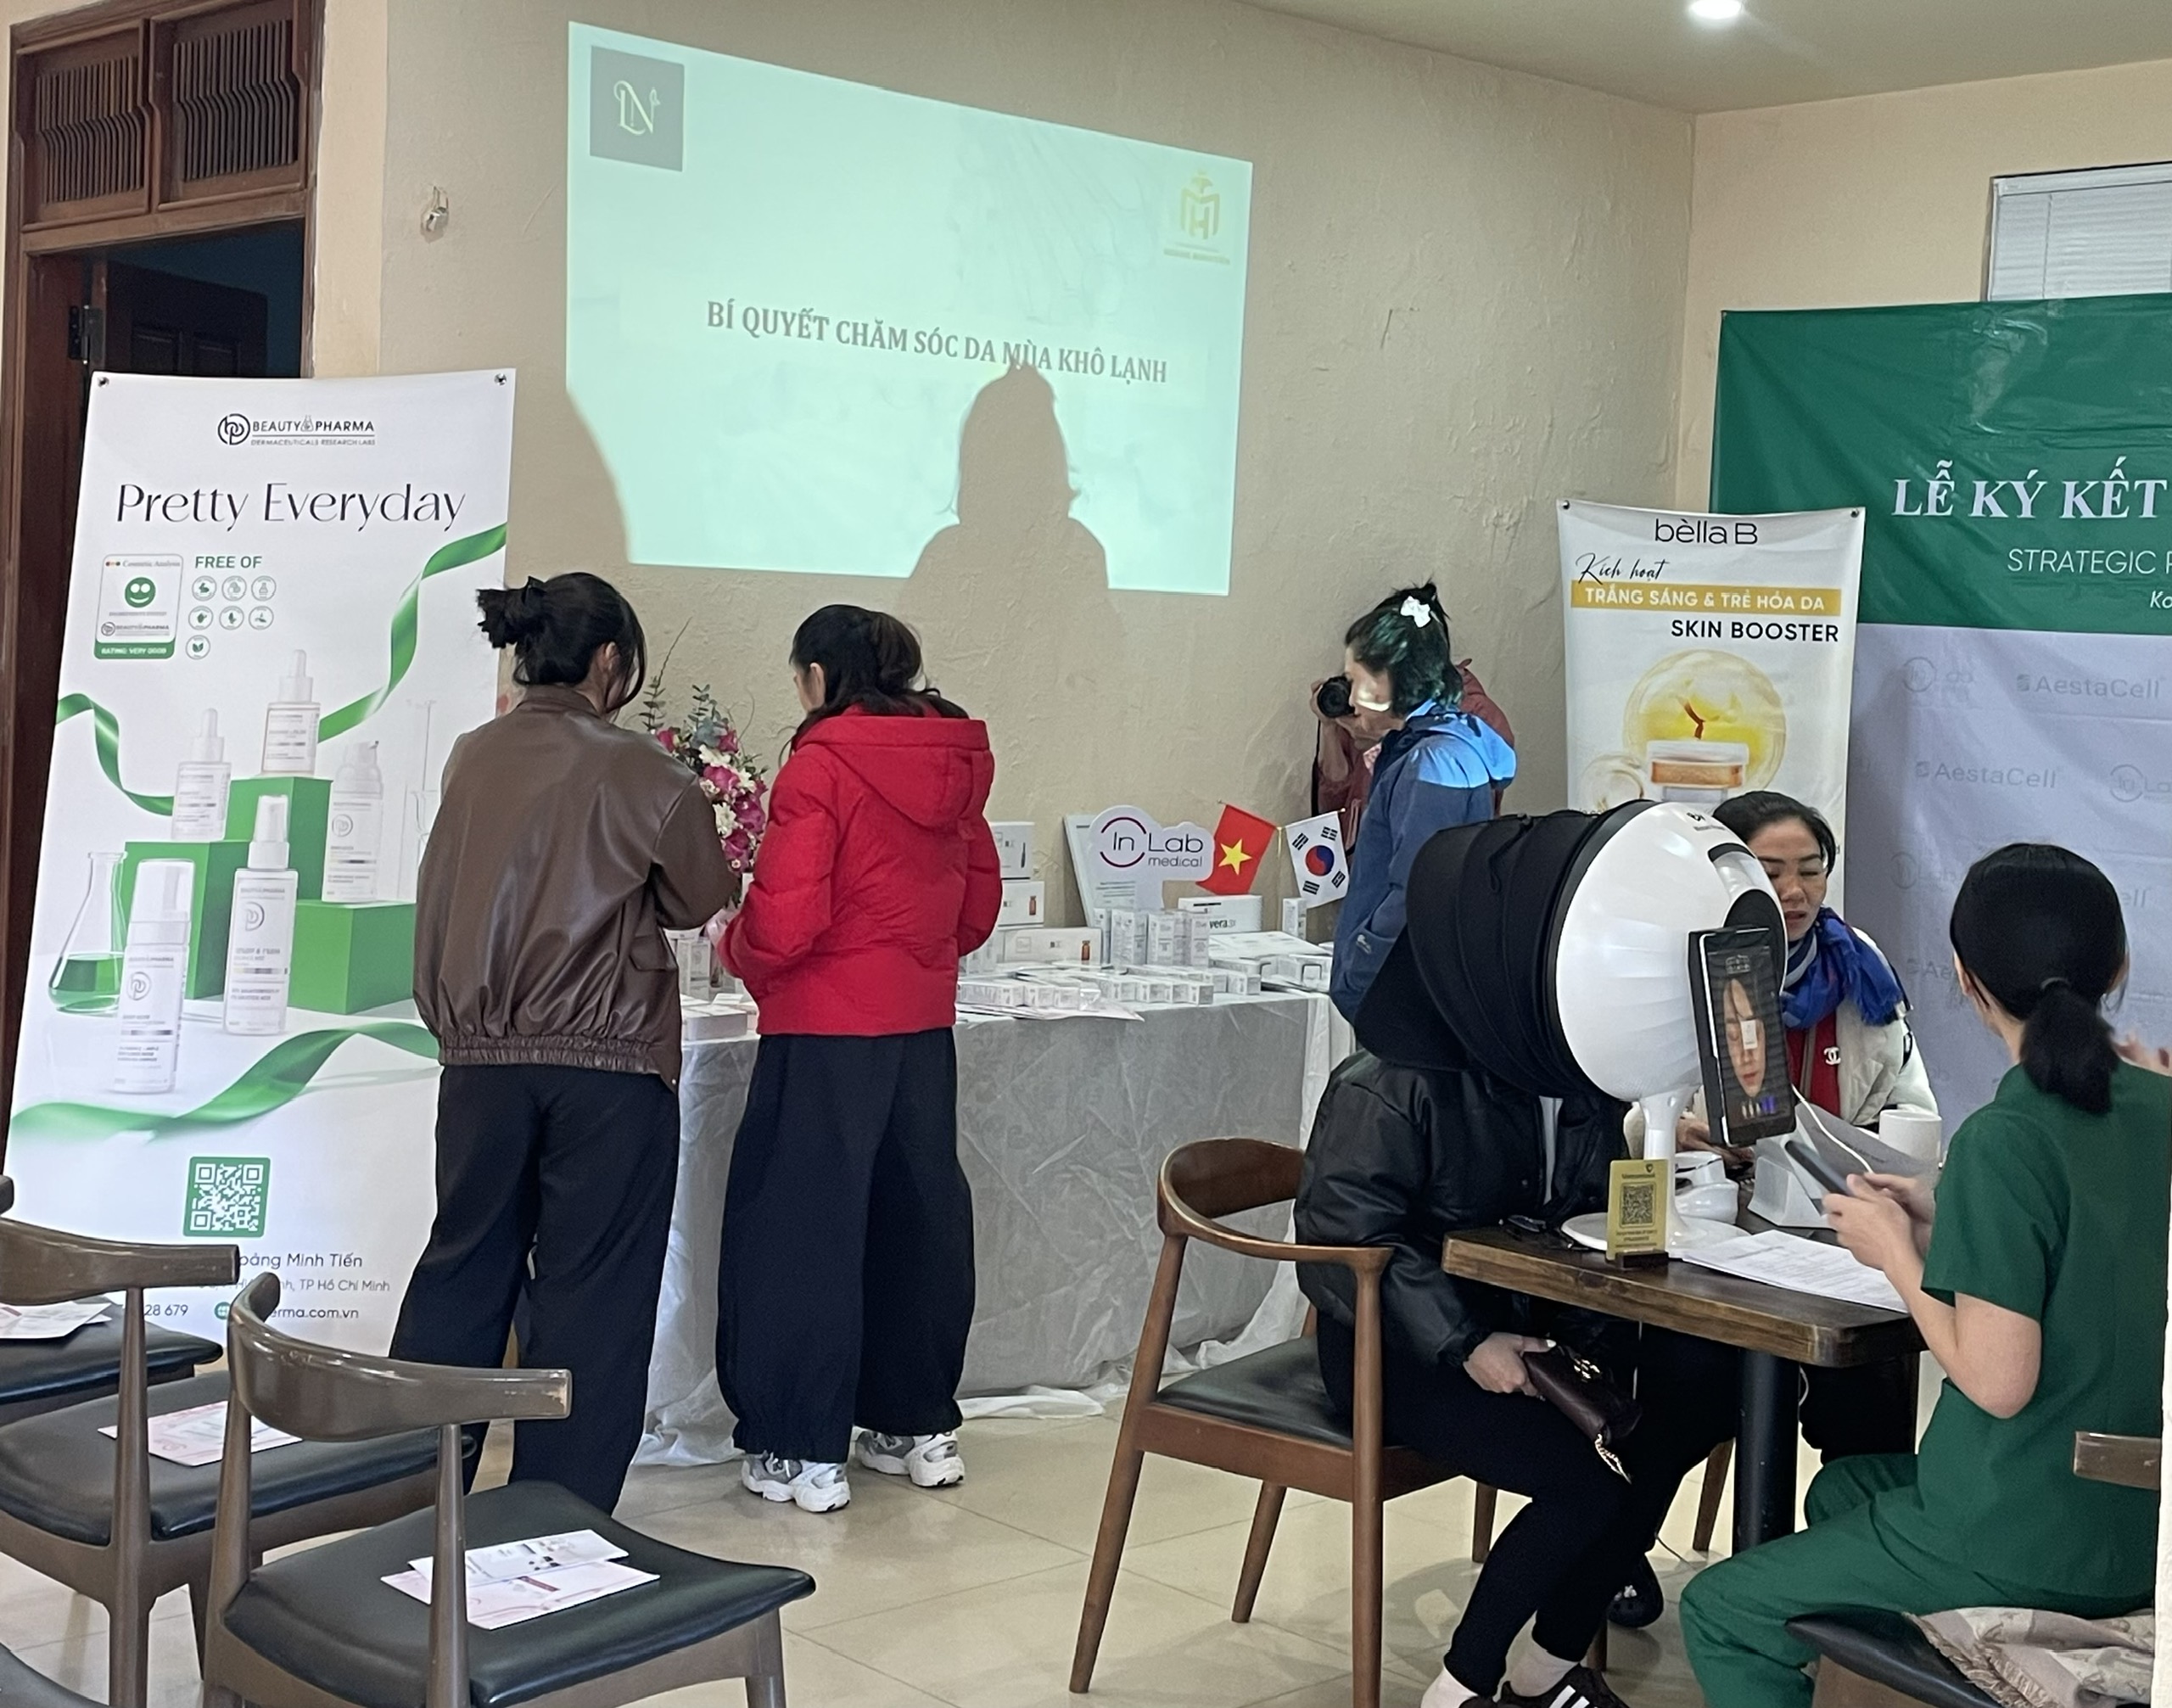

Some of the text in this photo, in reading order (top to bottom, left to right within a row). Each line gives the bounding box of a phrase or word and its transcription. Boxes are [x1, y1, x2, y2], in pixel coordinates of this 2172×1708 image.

[708, 299, 1167, 385] BÍ QUYẾT CHĂM SÓC DA MÙA KHÔ LẠNH
[252, 421, 301, 432] BEAUTY
[315, 421, 374, 432] PHARMA
[1891, 456, 2168, 519] LỄ KÝ KẾT
[117, 483, 467, 532] Pretty Everyday
[1655, 518, 1757, 545] bèlla B
[195, 556, 262, 568] FREE OF
[2007, 548, 2157, 574] STRATEGIC
[1649, 587, 1698, 606] SÁNG
[1704, 593, 1715, 608] &
[1757, 591, 1795, 610] HÓA
[1800, 597, 1825, 610] DA
[1671, 619, 1839, 641] SKIN BOOSTER
[2035, 675, 2160, 699] AestaCell
[1934, 763, 2057, 788] AestaCell
[1148, 856, 1203, 867] medical
[287, 1253, 324, 1267] Minh
[329, 1252, 362, 1267] Tiến
[299, 1279, 314, 1290] TP
[361, 1280, 390, 1291] Minh
[144, 1304, 188, 1316] 28 679
[271, 1308, 359, 1319] erma.com.vn
